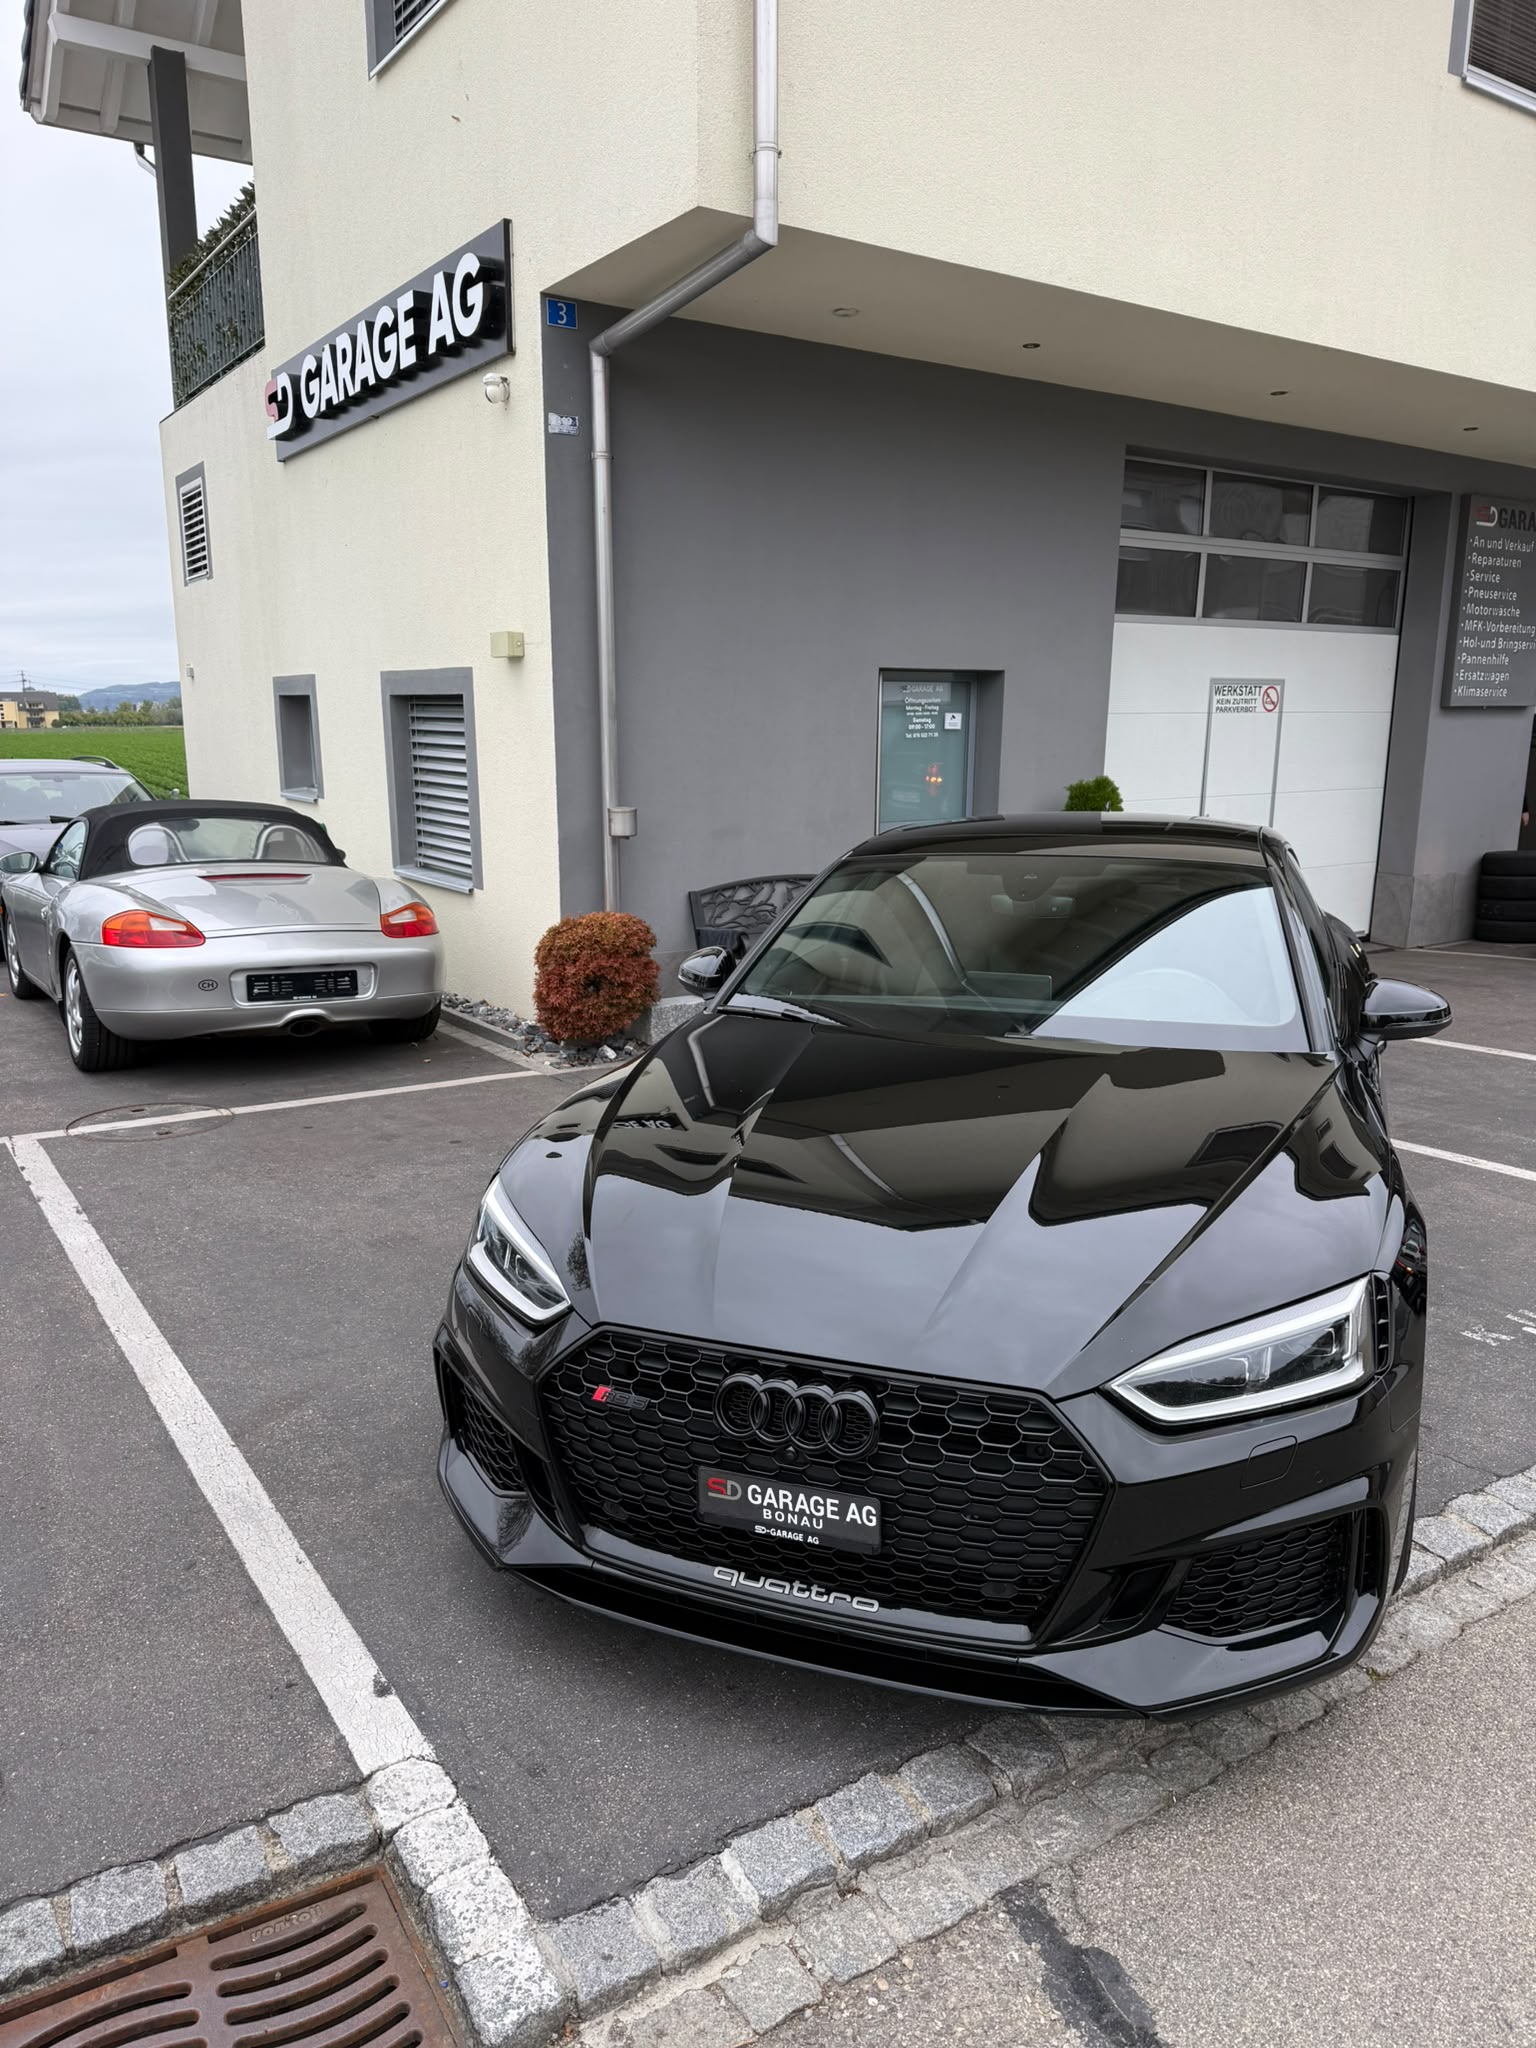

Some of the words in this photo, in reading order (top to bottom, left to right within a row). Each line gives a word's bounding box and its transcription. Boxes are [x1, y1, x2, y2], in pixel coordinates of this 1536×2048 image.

[557, 303, 567, 325] 3
[300, 290, 417, 419] GARAGE
[428, 252, 484, 355] AG
[1487, 538, 1503, 550] und
[1504, 538, 1535, 553] Verkauf
[1469, 569, 1501, 583] Service
[1214, 685, 1262, 696] WERKSTATT
[707, 1477, 742, 1501] SD
[747, 1484, 840, 1520] GARAGE
[845, 1502, 877, 1527] AG
[762, 1508, 823, 1529] BONAU
[807, 1536, 819, 1545] AG
[713, 1566, 879, 1613] quattro
